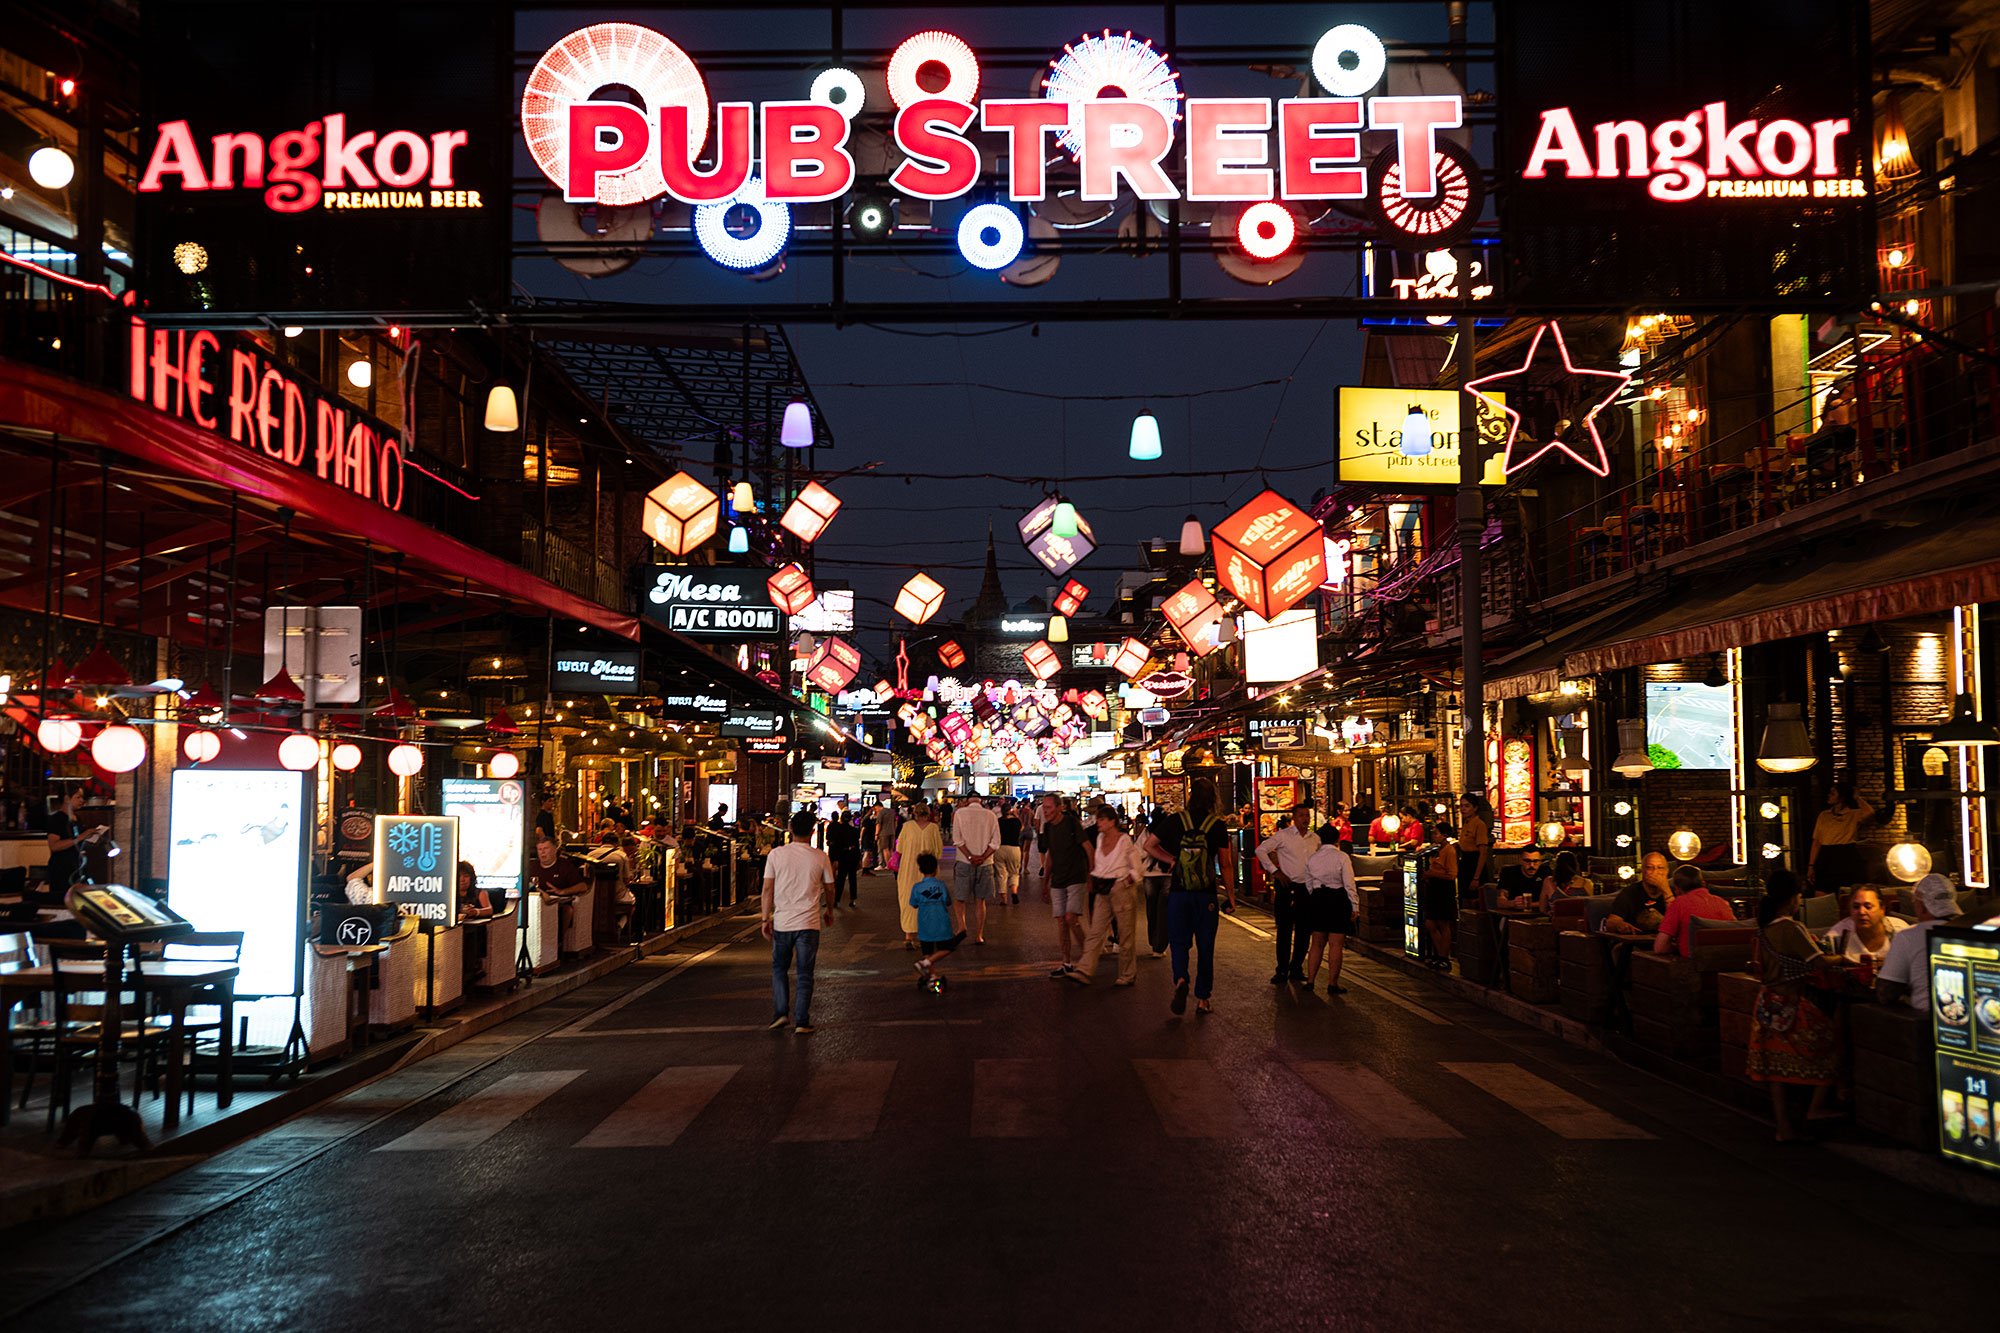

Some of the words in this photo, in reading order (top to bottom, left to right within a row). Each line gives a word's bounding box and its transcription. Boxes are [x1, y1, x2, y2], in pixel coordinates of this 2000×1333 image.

[563, 100, 856, 205] PUB
[889, 96, 1463, 202] STREET
[1523, 101, 1850, 202] Angkor
[139, 113, 469, 212] Angkor
[1707, 180, 1808, 198] PREMIUM
[1812, 179, 1867, 198] BEER
[323, 191, 424, 209] PREMIUM
[430, 190, 483, 208] BEER
[123, 290, 220, 430] THE
[229, 348, 307, 466] RED
[315, 398, 404, 511] PIANO
[1356, 421, 1461, 449] staon
[1417, 453, 1460, 467] stree
[1239, 507, 1294, 547] TEMPLE
[1271, 554, 1320, 594] TEMPLE
[649, 572, 741, 604] Mesa
[673, 608, 709, 630] A/C
[714, 609, 774, 628] ROOM
[590, 659, 636, 675] Mesa
[1143, 679, 1190, 690] speakeasy
[693, 695, 727, 708] Mesa
[387, 876, 443, 893] AIR-CON
[398, 902, 447, 921] STAIRS
[1965, 1076, 1988, 1096] 1+1
